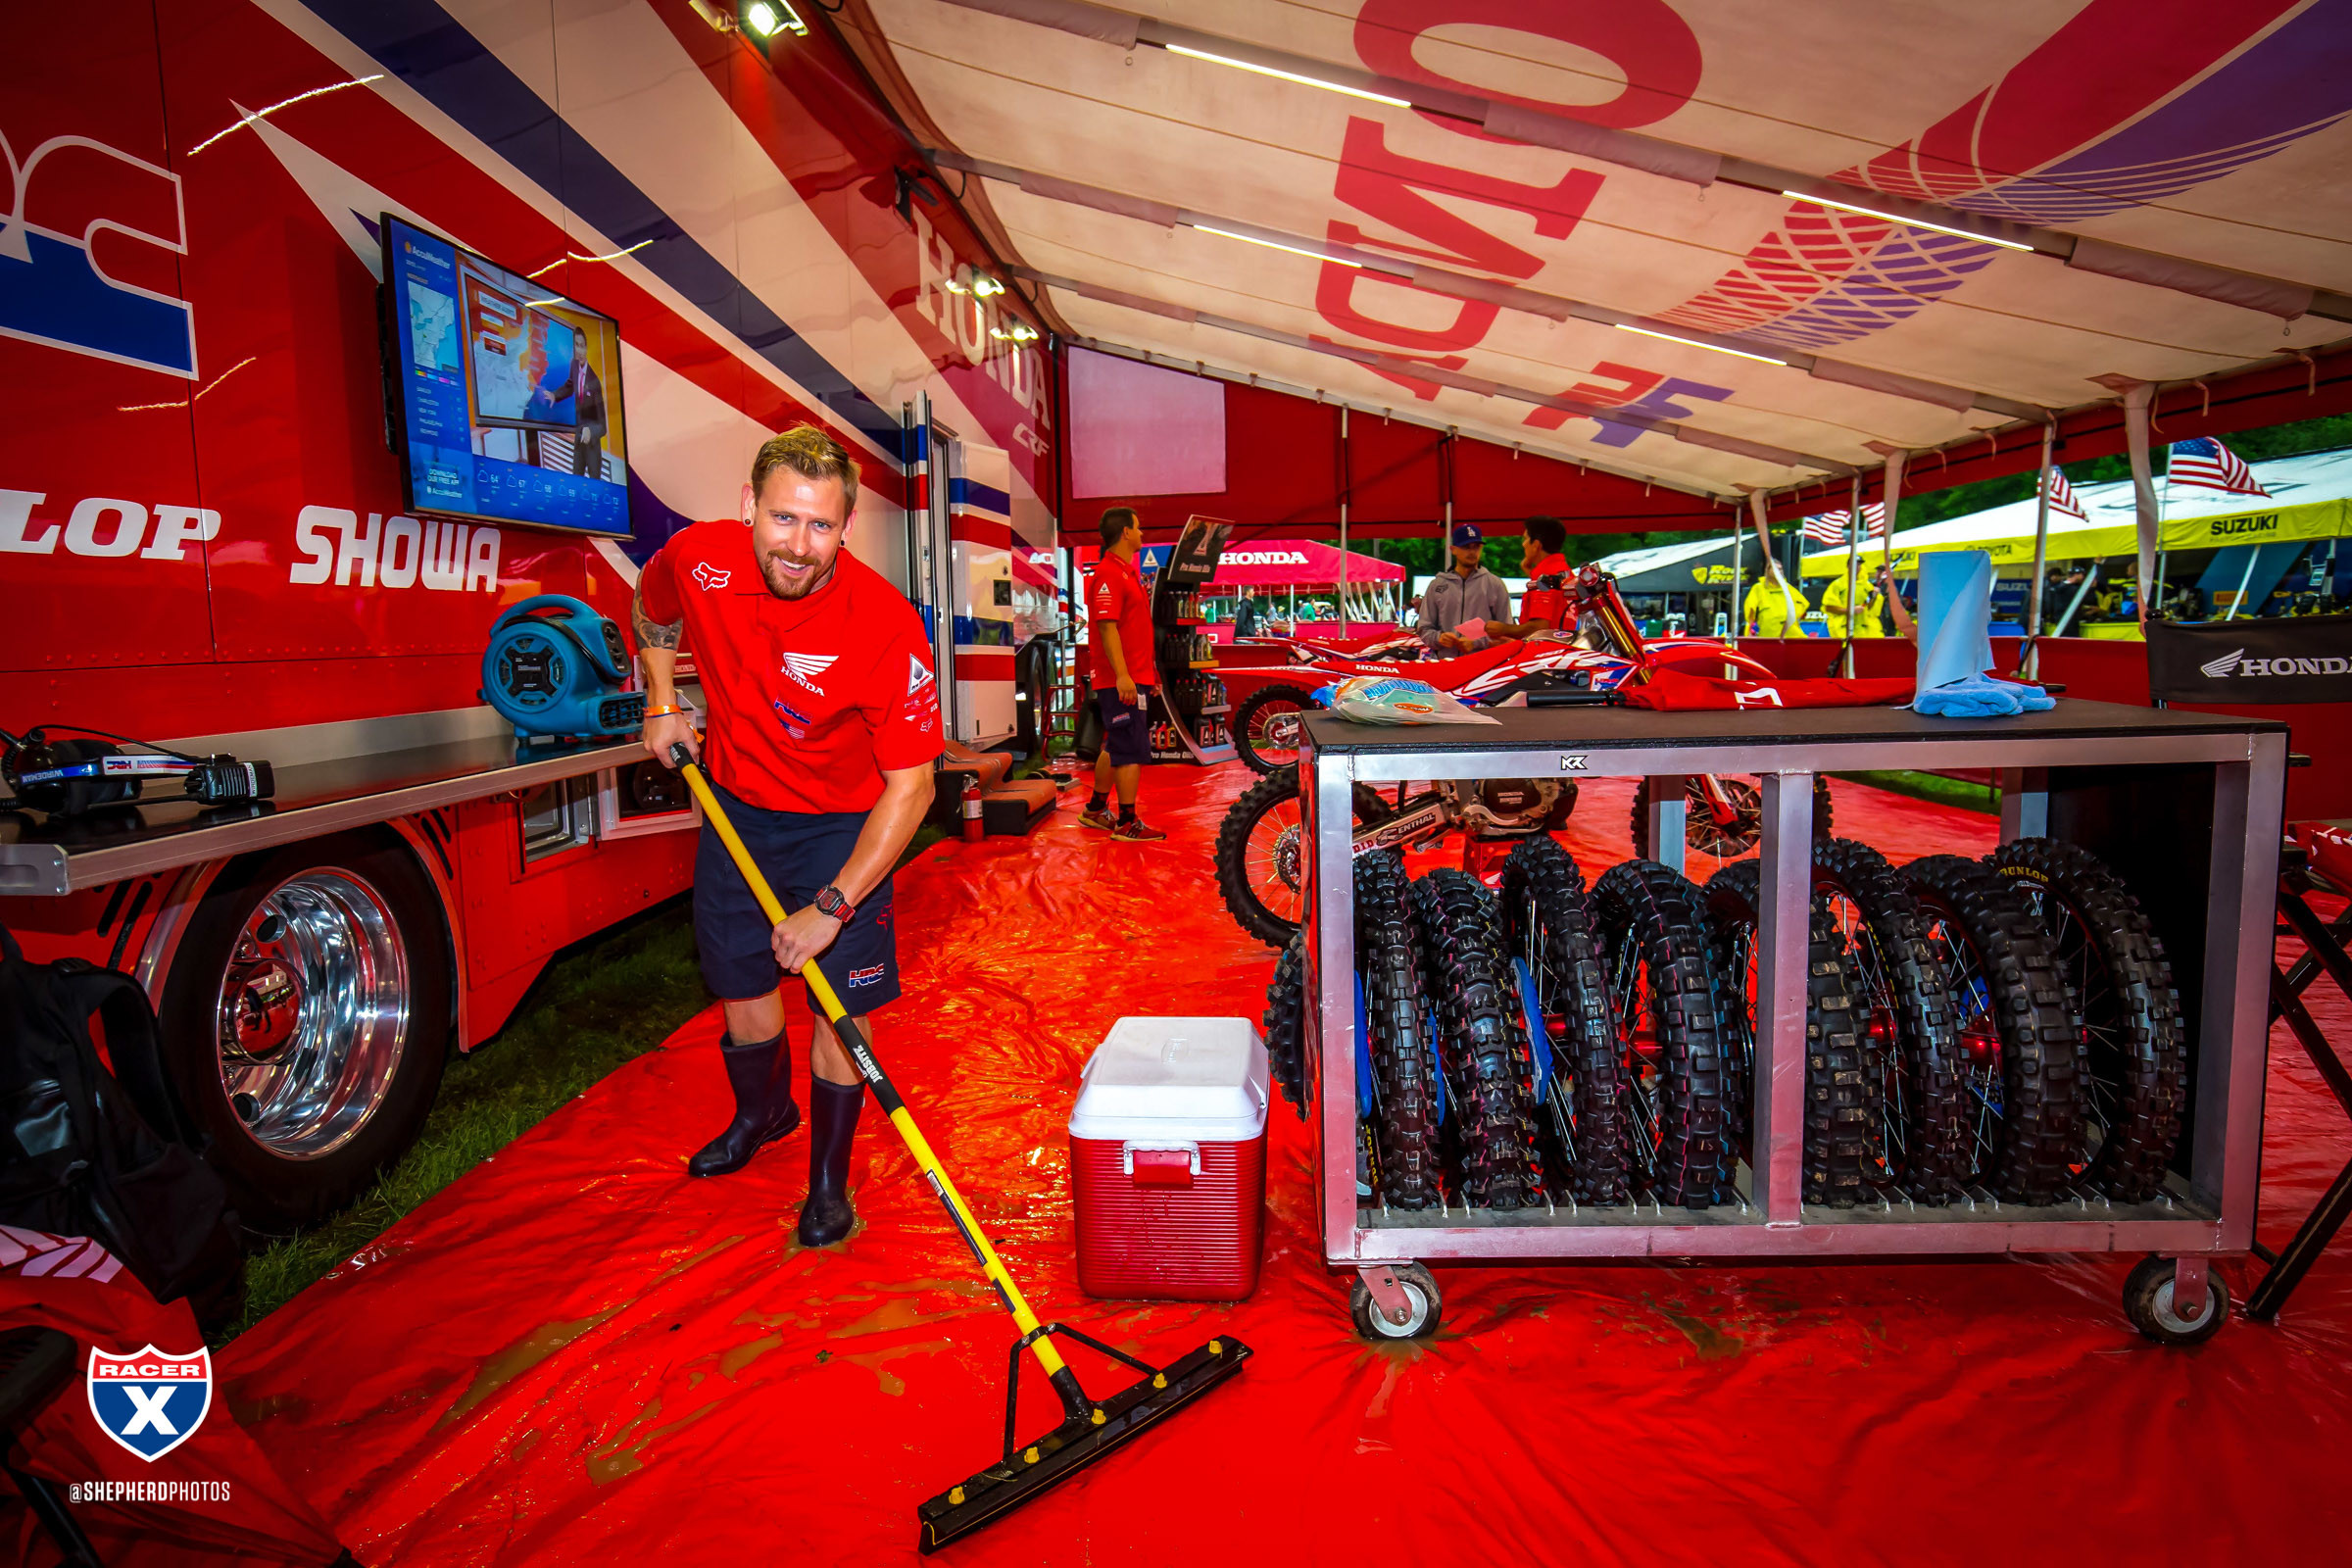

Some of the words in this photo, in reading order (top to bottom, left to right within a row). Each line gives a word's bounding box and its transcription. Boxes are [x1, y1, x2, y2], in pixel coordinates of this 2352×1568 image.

[912, 203, 1051, 430] HONDA
[1012, 422, 1050, 458] CRF
[490, 473, 499, 483] 64
[2211, 514, 2278, 536] SUZUKI
[289, 505, 501, 593] SHOWA
[1218, 551, 1309, 565] HONDA
[1355, 663, 1401, 674] HONDA
[2239, 657, 2352, 677] HOND
[780, 665, 825, 697] HONDA
[107, 760, 132, 770] HRC
[849, 962, 885, 988] HRC
[853, 1044, 884, 1084] JOBSITE
